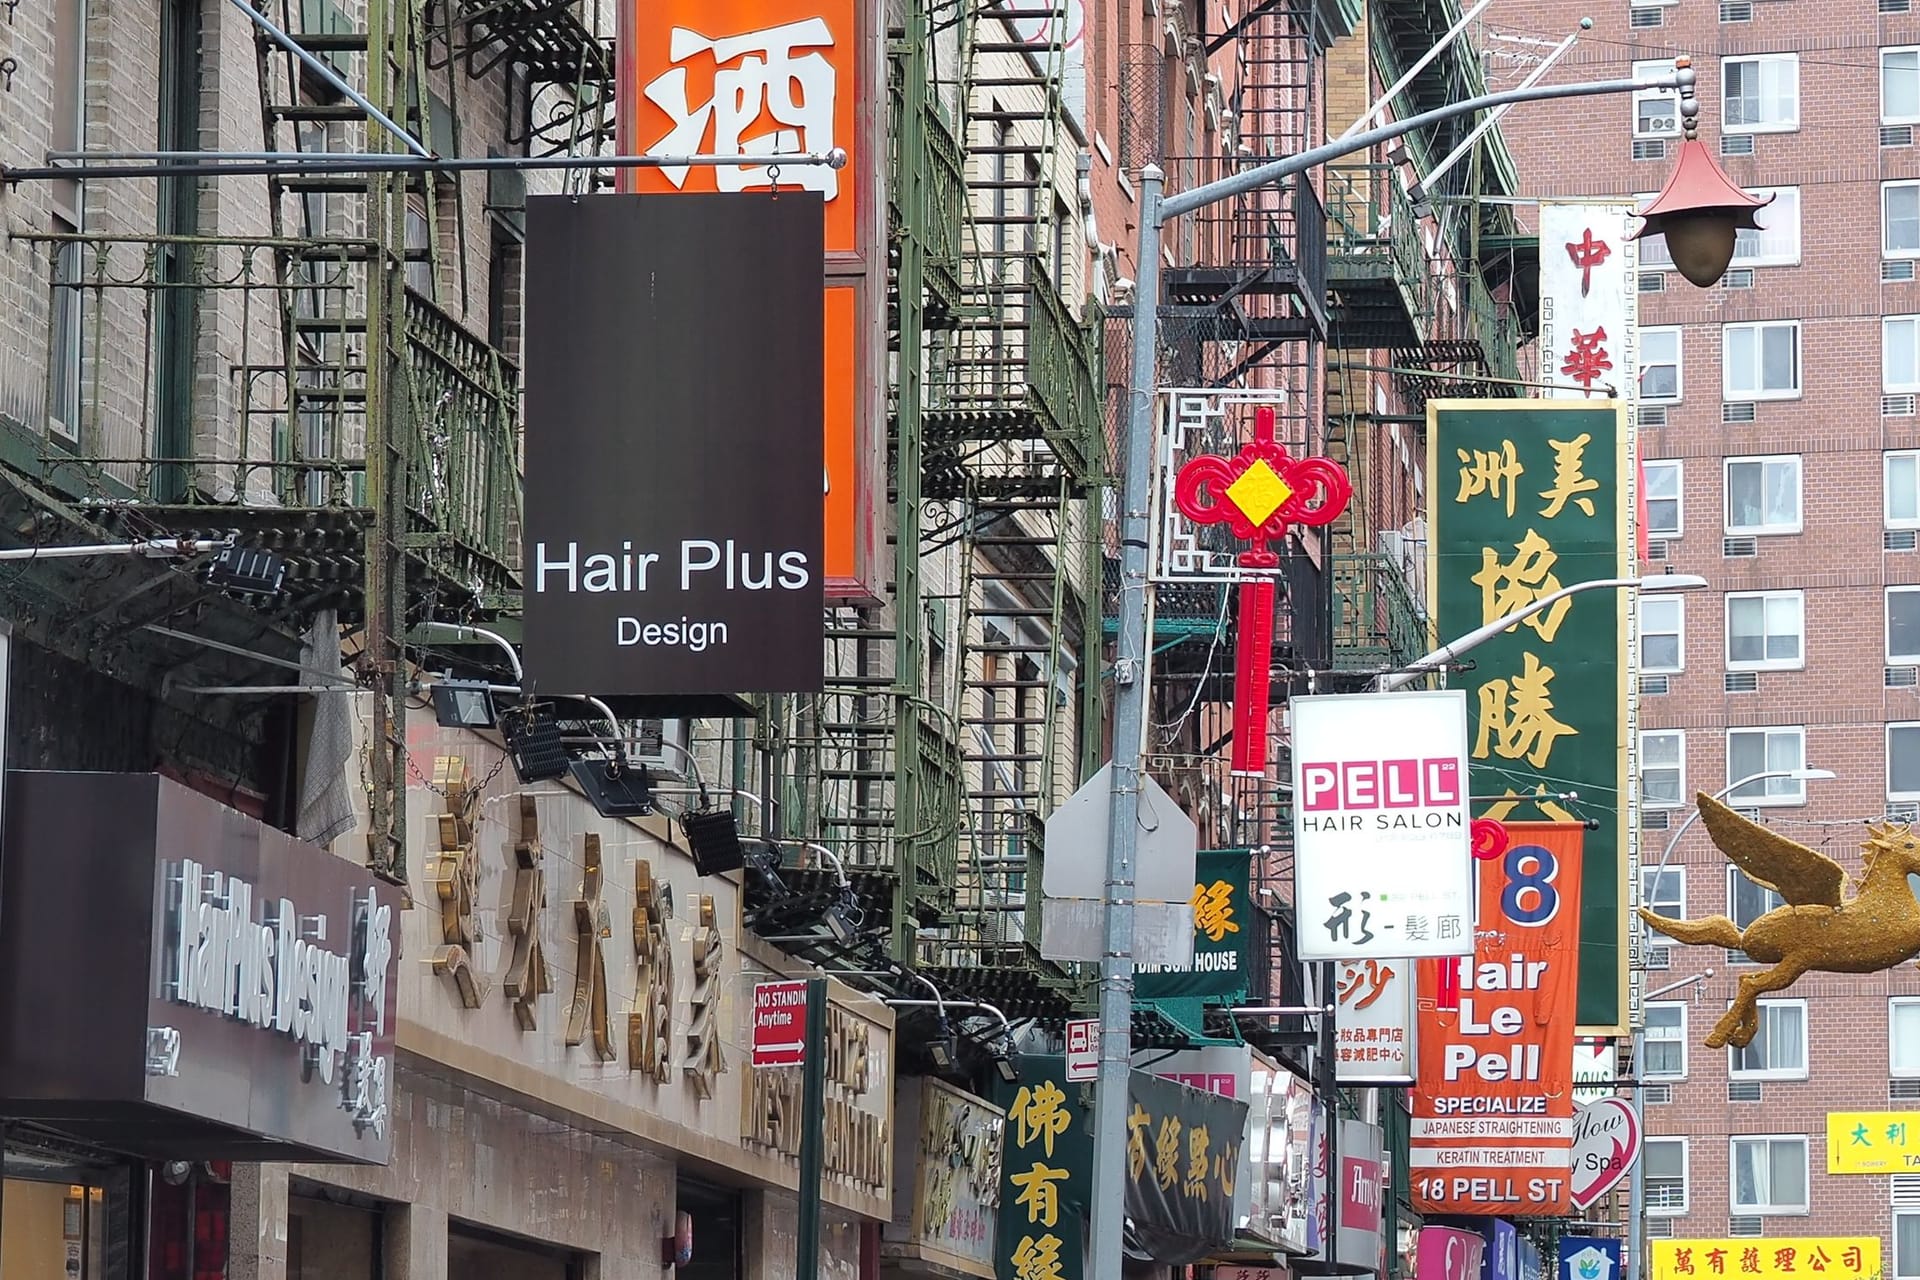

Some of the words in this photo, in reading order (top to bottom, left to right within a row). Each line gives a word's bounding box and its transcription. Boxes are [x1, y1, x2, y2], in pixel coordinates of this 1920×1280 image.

[1560, 227, 1613, 399] 中華
[536, 541, 659, 593] Hair
[681, 539, 810, 591] Plus
[617, 616, 728, 652] Design
[1302, 760, 1458, 810] PELL
[1303, 815, 1363, 832] HAIR
[1376, 812, 1461, 830] SALON
[1195, 951, 1237, 972] HOUSE
[276, 897, 349, 1085] Design
[758, 993, 770, 1008] NO
[772, 990, 807, 1007] STANDIN
[758, 1011, 793, 1029] Anytime
[1459, 998, 1524, 1036] Le
[1444, 1044, 1541, 1082] Pell
[1434, 1096, 1547, 1115] SPECIALIZE
[1422, 1121, 1476, 1135] JAPANESE
[1478, 1121, 1562, 1135] STRAIGHTENING
[1436, 1151, 1480, 1164] KERATIN
[1483, 1151, 1545, 1164] TREATMENT
[1585, 1152, 1623, 1175] Spa
[1419, 1178, 1446, 1201] 18
[1453, 1178, 1520, 1201] PELL
[1528, 1178, 1563, 1202] ST
